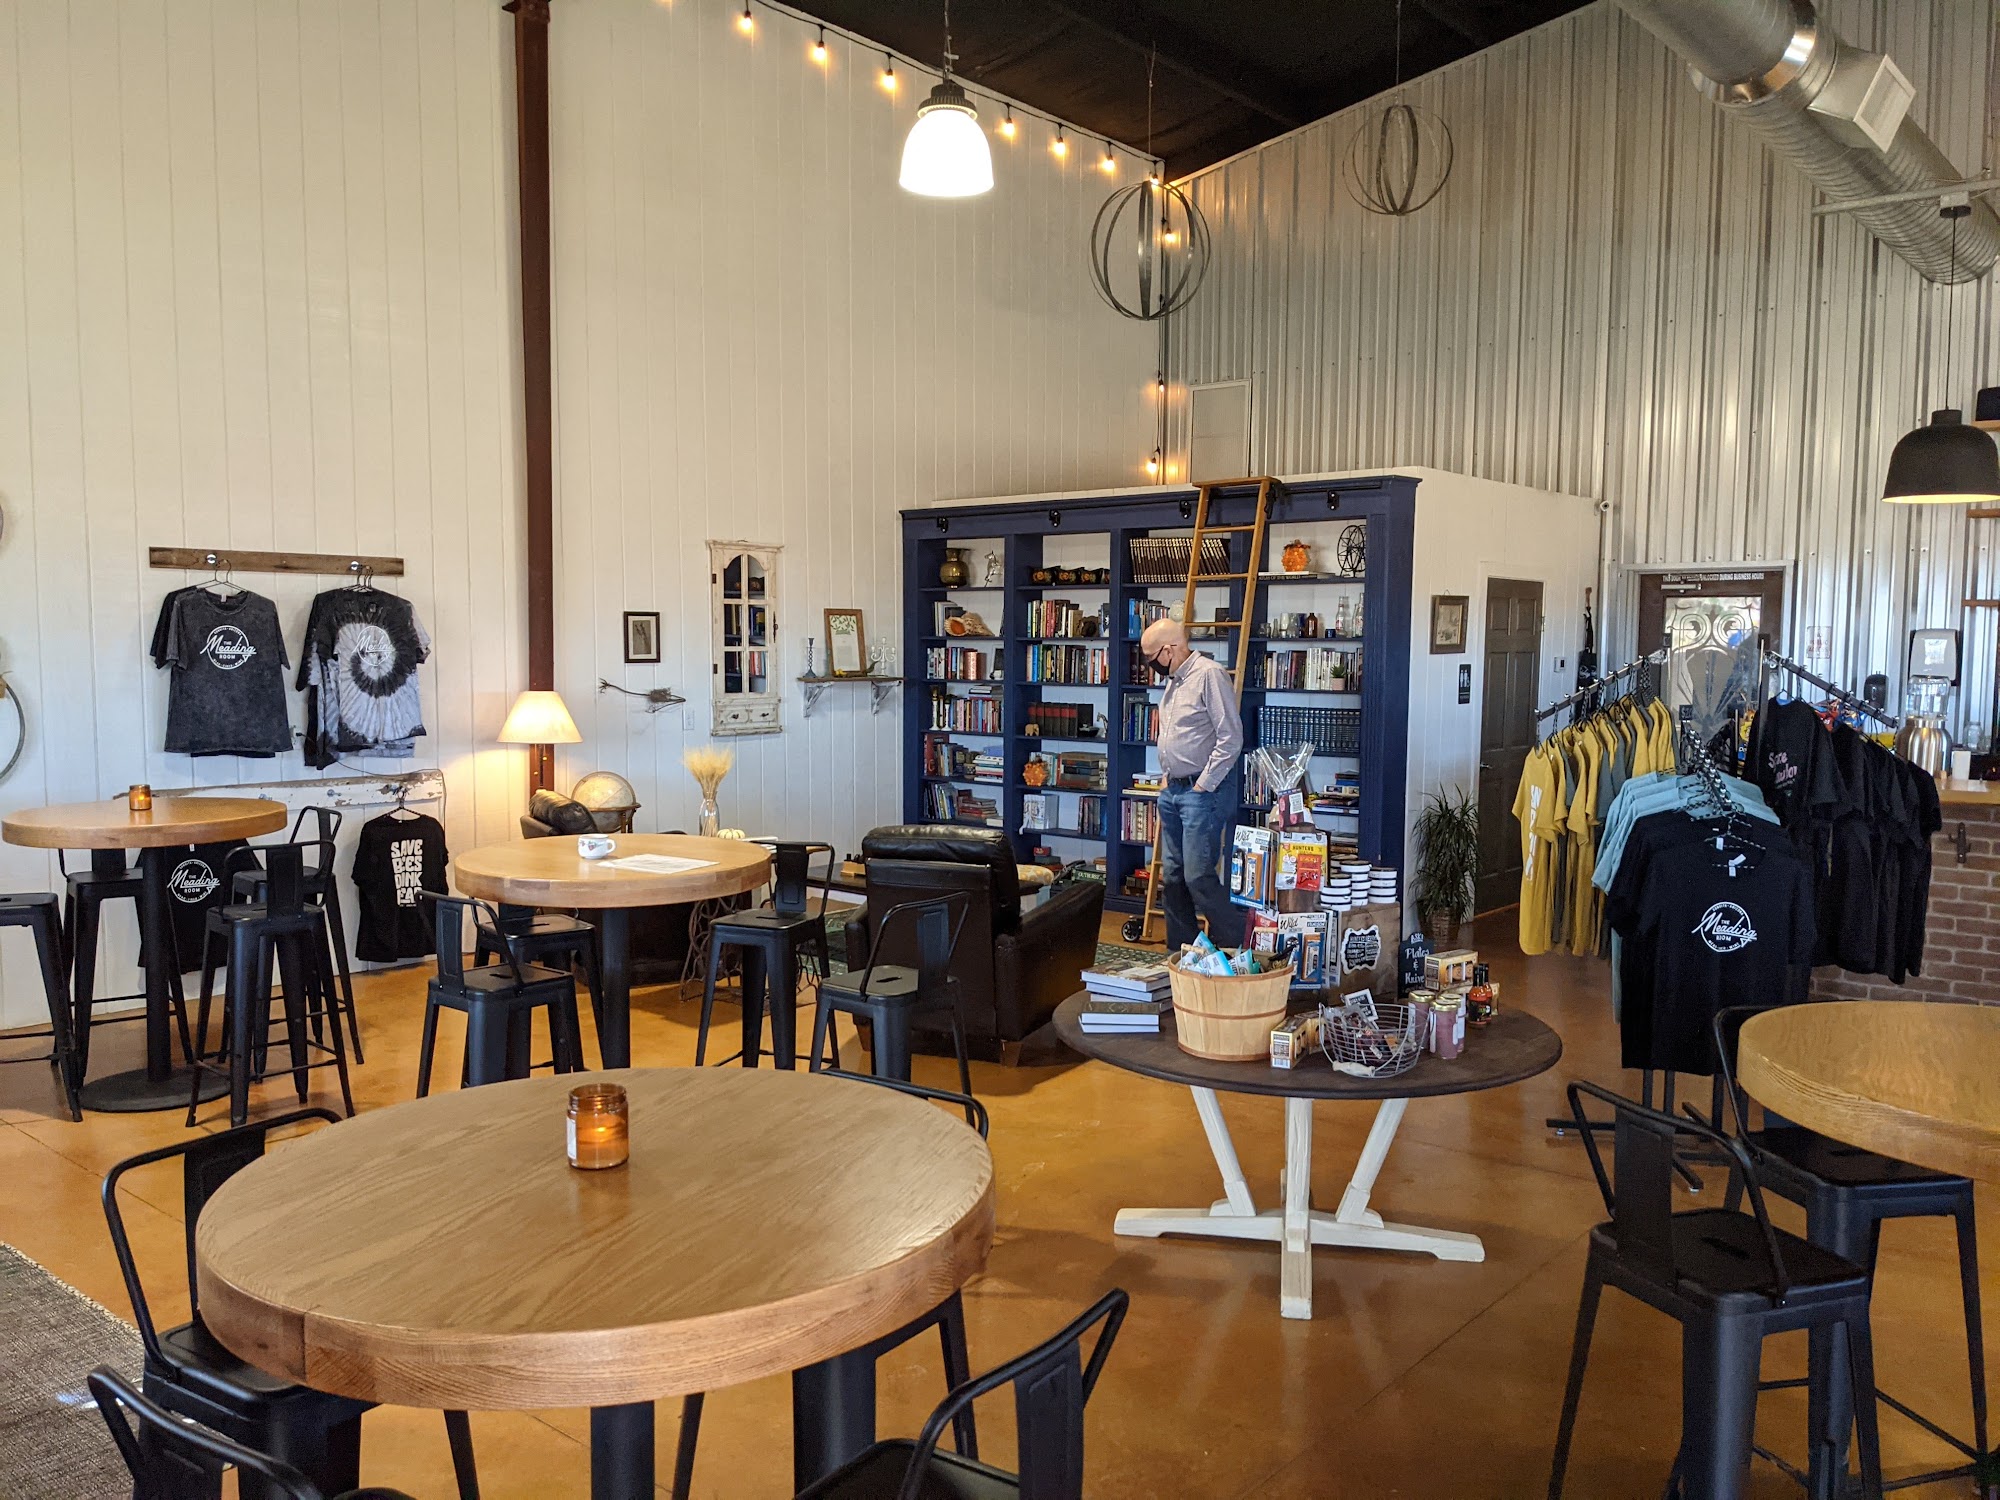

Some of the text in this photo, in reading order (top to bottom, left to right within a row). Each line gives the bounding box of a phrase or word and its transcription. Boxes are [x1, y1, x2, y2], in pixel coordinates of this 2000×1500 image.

[199, 634, 257, 660] Meading
[391, 839, 423, 858] SAVE
[391, 855, 423, 874] BEES
[166, 868, 221, 892] Meading
[394, 871, 423, 889] DINK
[1279, 915, 1299, 930] Wild
[1691, 911, 1757, 944] Meading
[1404, 946, 1430, 959] Plates
[1412, 959, 1419, 971] &
[1404, 972, 1425, 985] Knive
